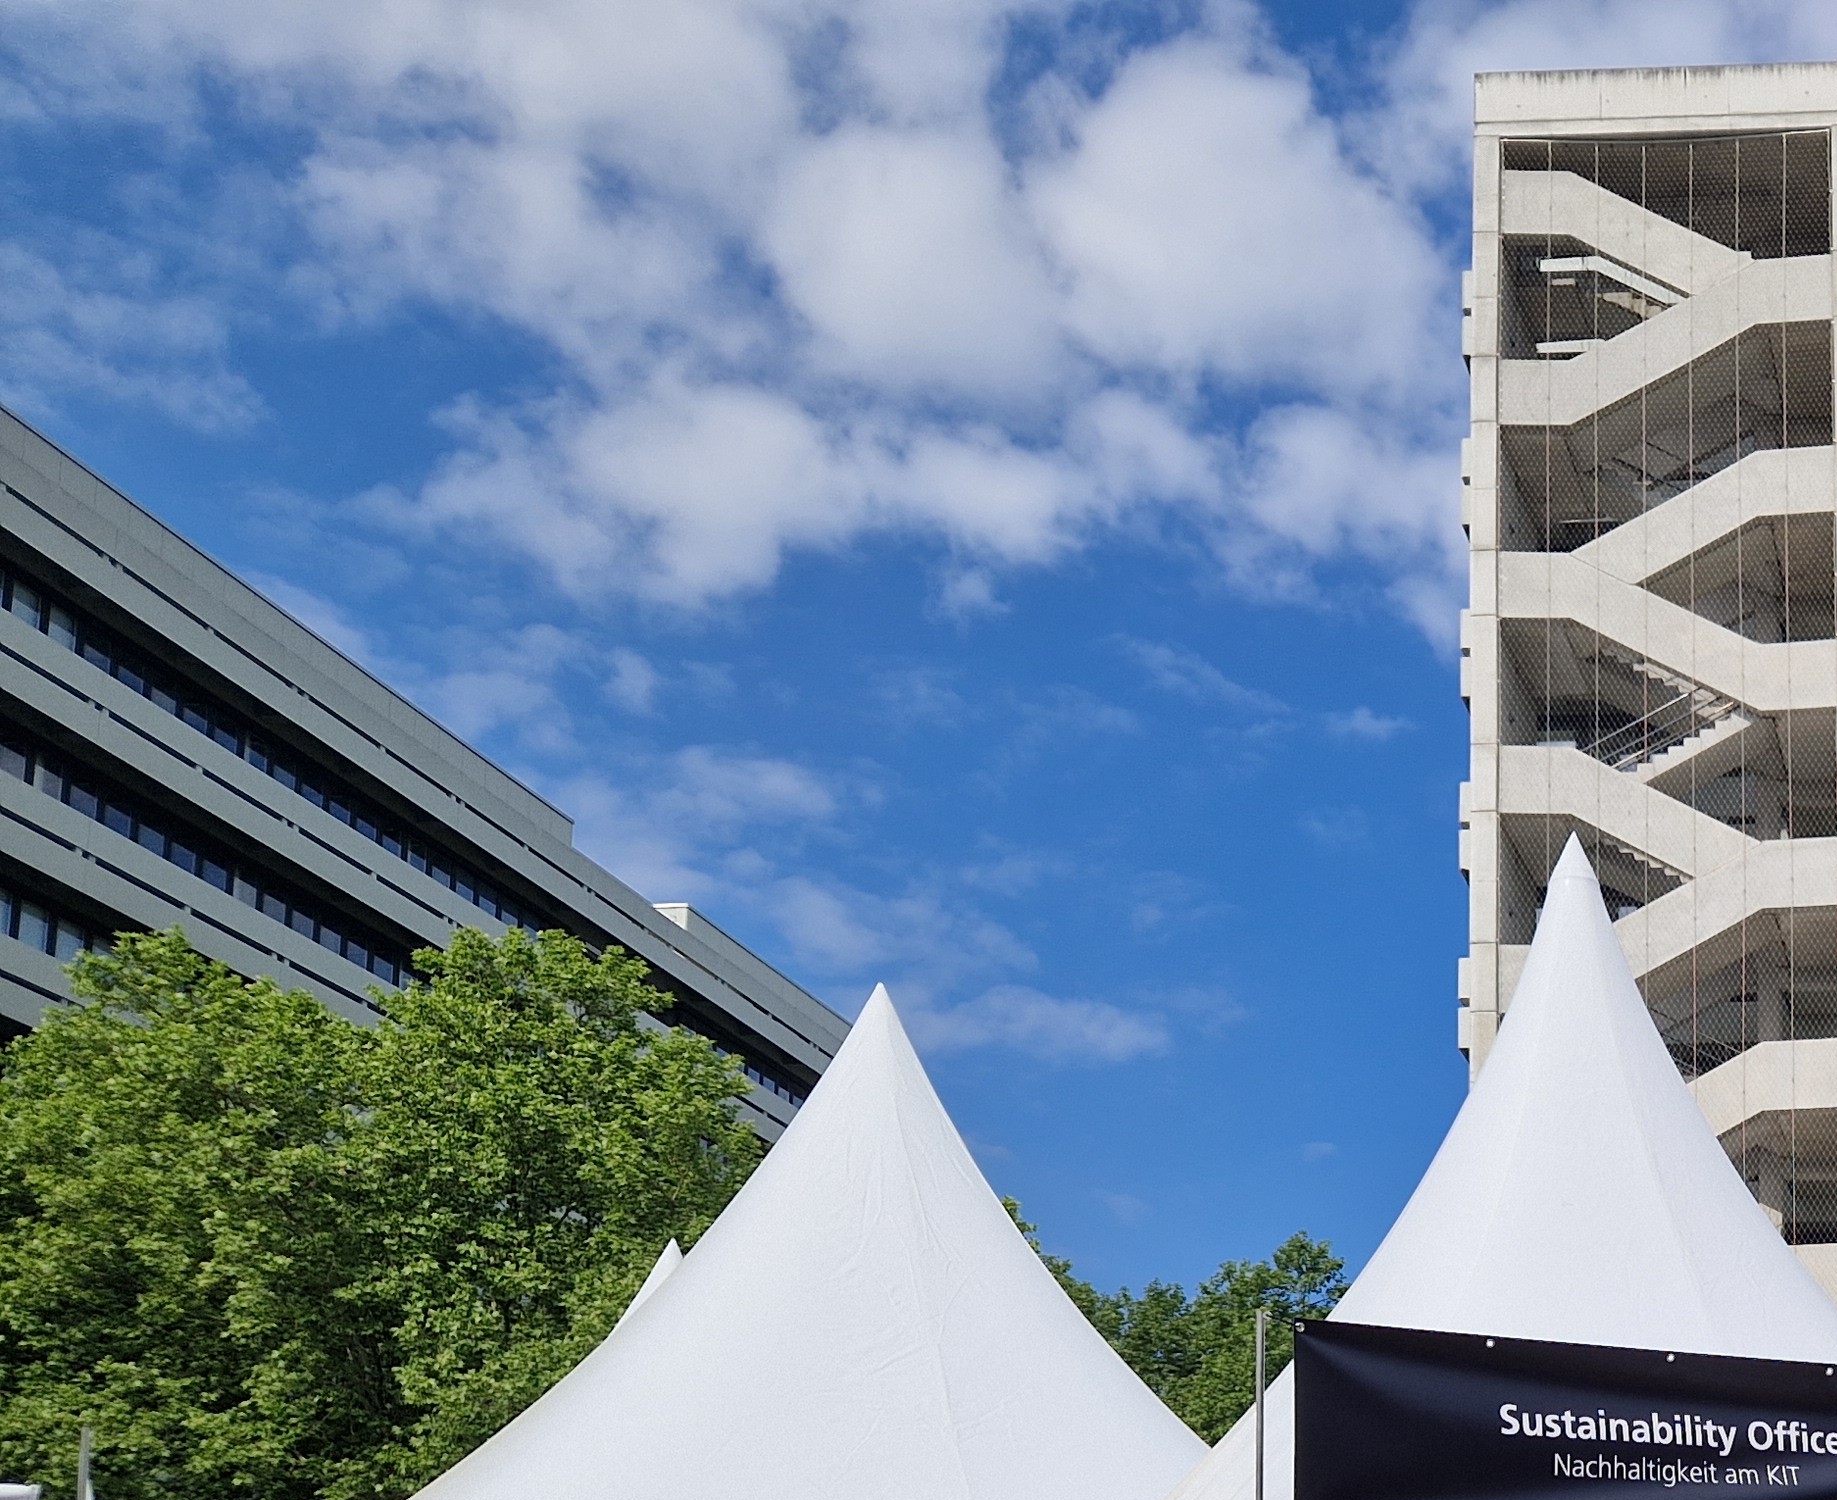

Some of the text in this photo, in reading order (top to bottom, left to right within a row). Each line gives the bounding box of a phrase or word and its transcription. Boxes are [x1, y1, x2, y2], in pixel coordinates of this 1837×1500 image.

[1499, 1404, 1737, 1456] Sustainability
[1553, 1453, 1800, 1487] Nachhaltigkeit am KIT
